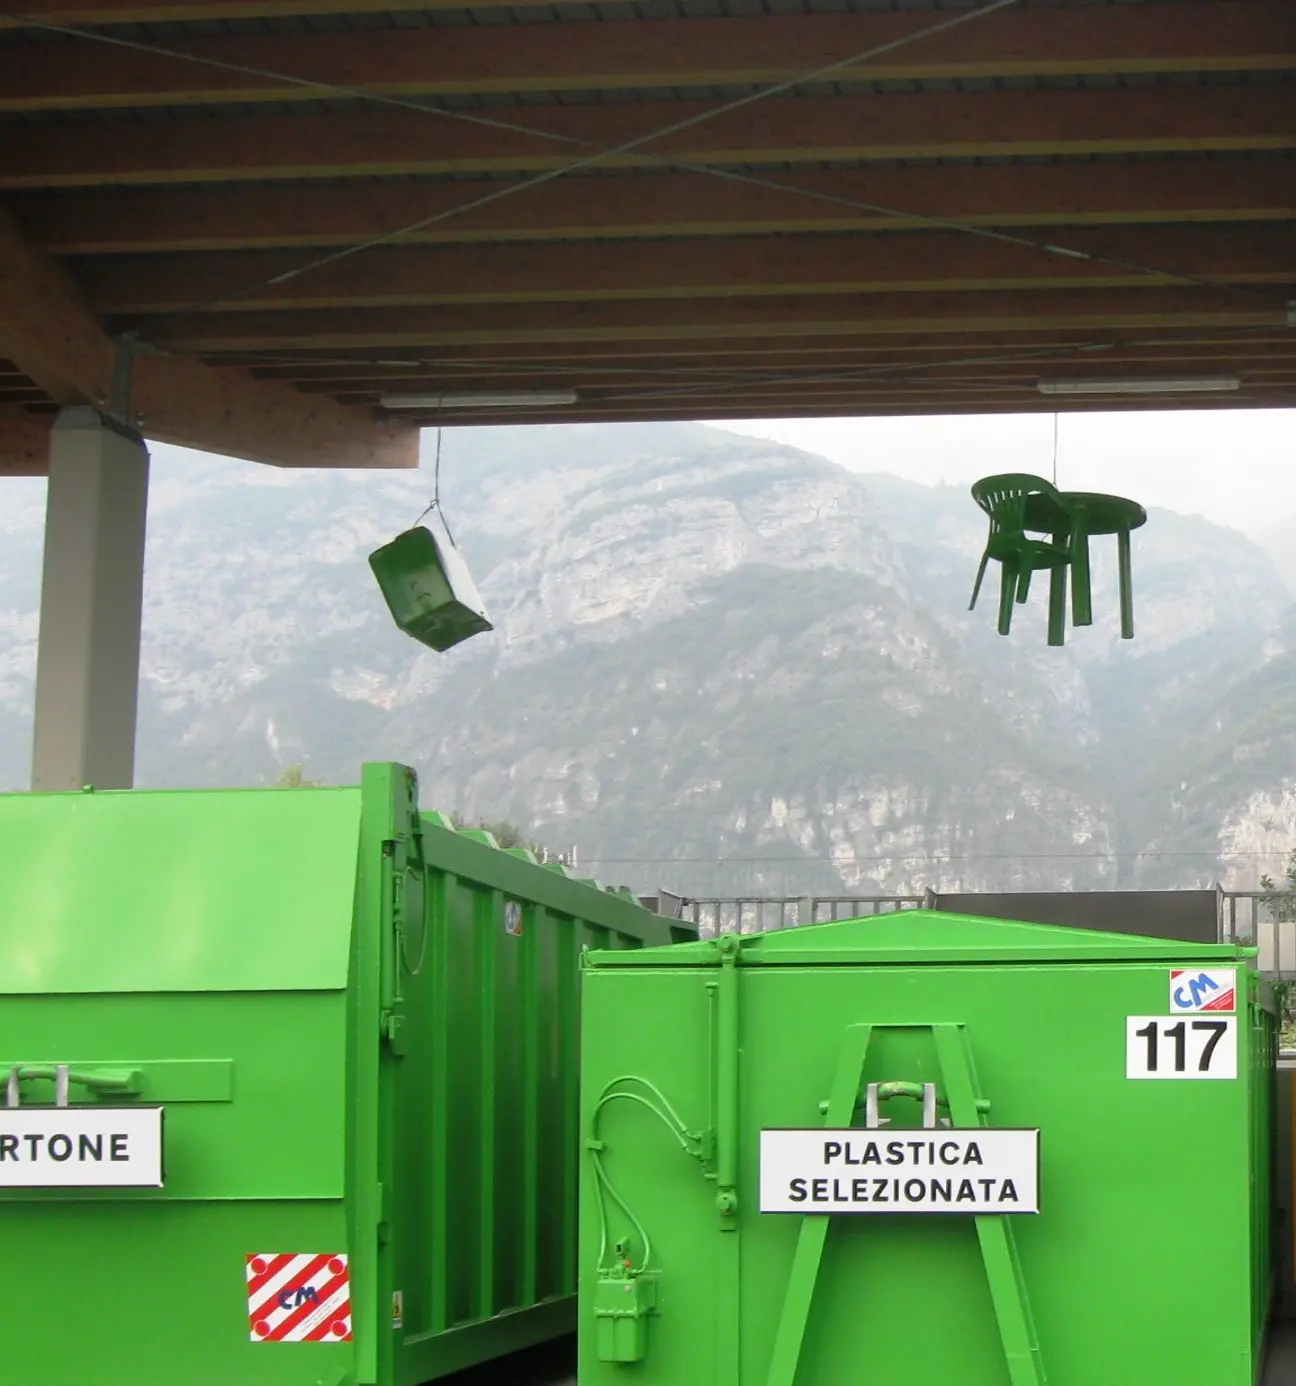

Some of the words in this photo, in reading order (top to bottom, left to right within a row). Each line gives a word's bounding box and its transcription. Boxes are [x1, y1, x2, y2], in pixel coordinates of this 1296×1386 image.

[1174, 973, 1219, 1008] CM
[1136, 1021, 1228, 1072] 117
[823, 1141, 984, 1165] PLASTICA
[788, 1178, 1019, 1203] SELEZIONATA
[278, 1286, 321, 1310] CM
